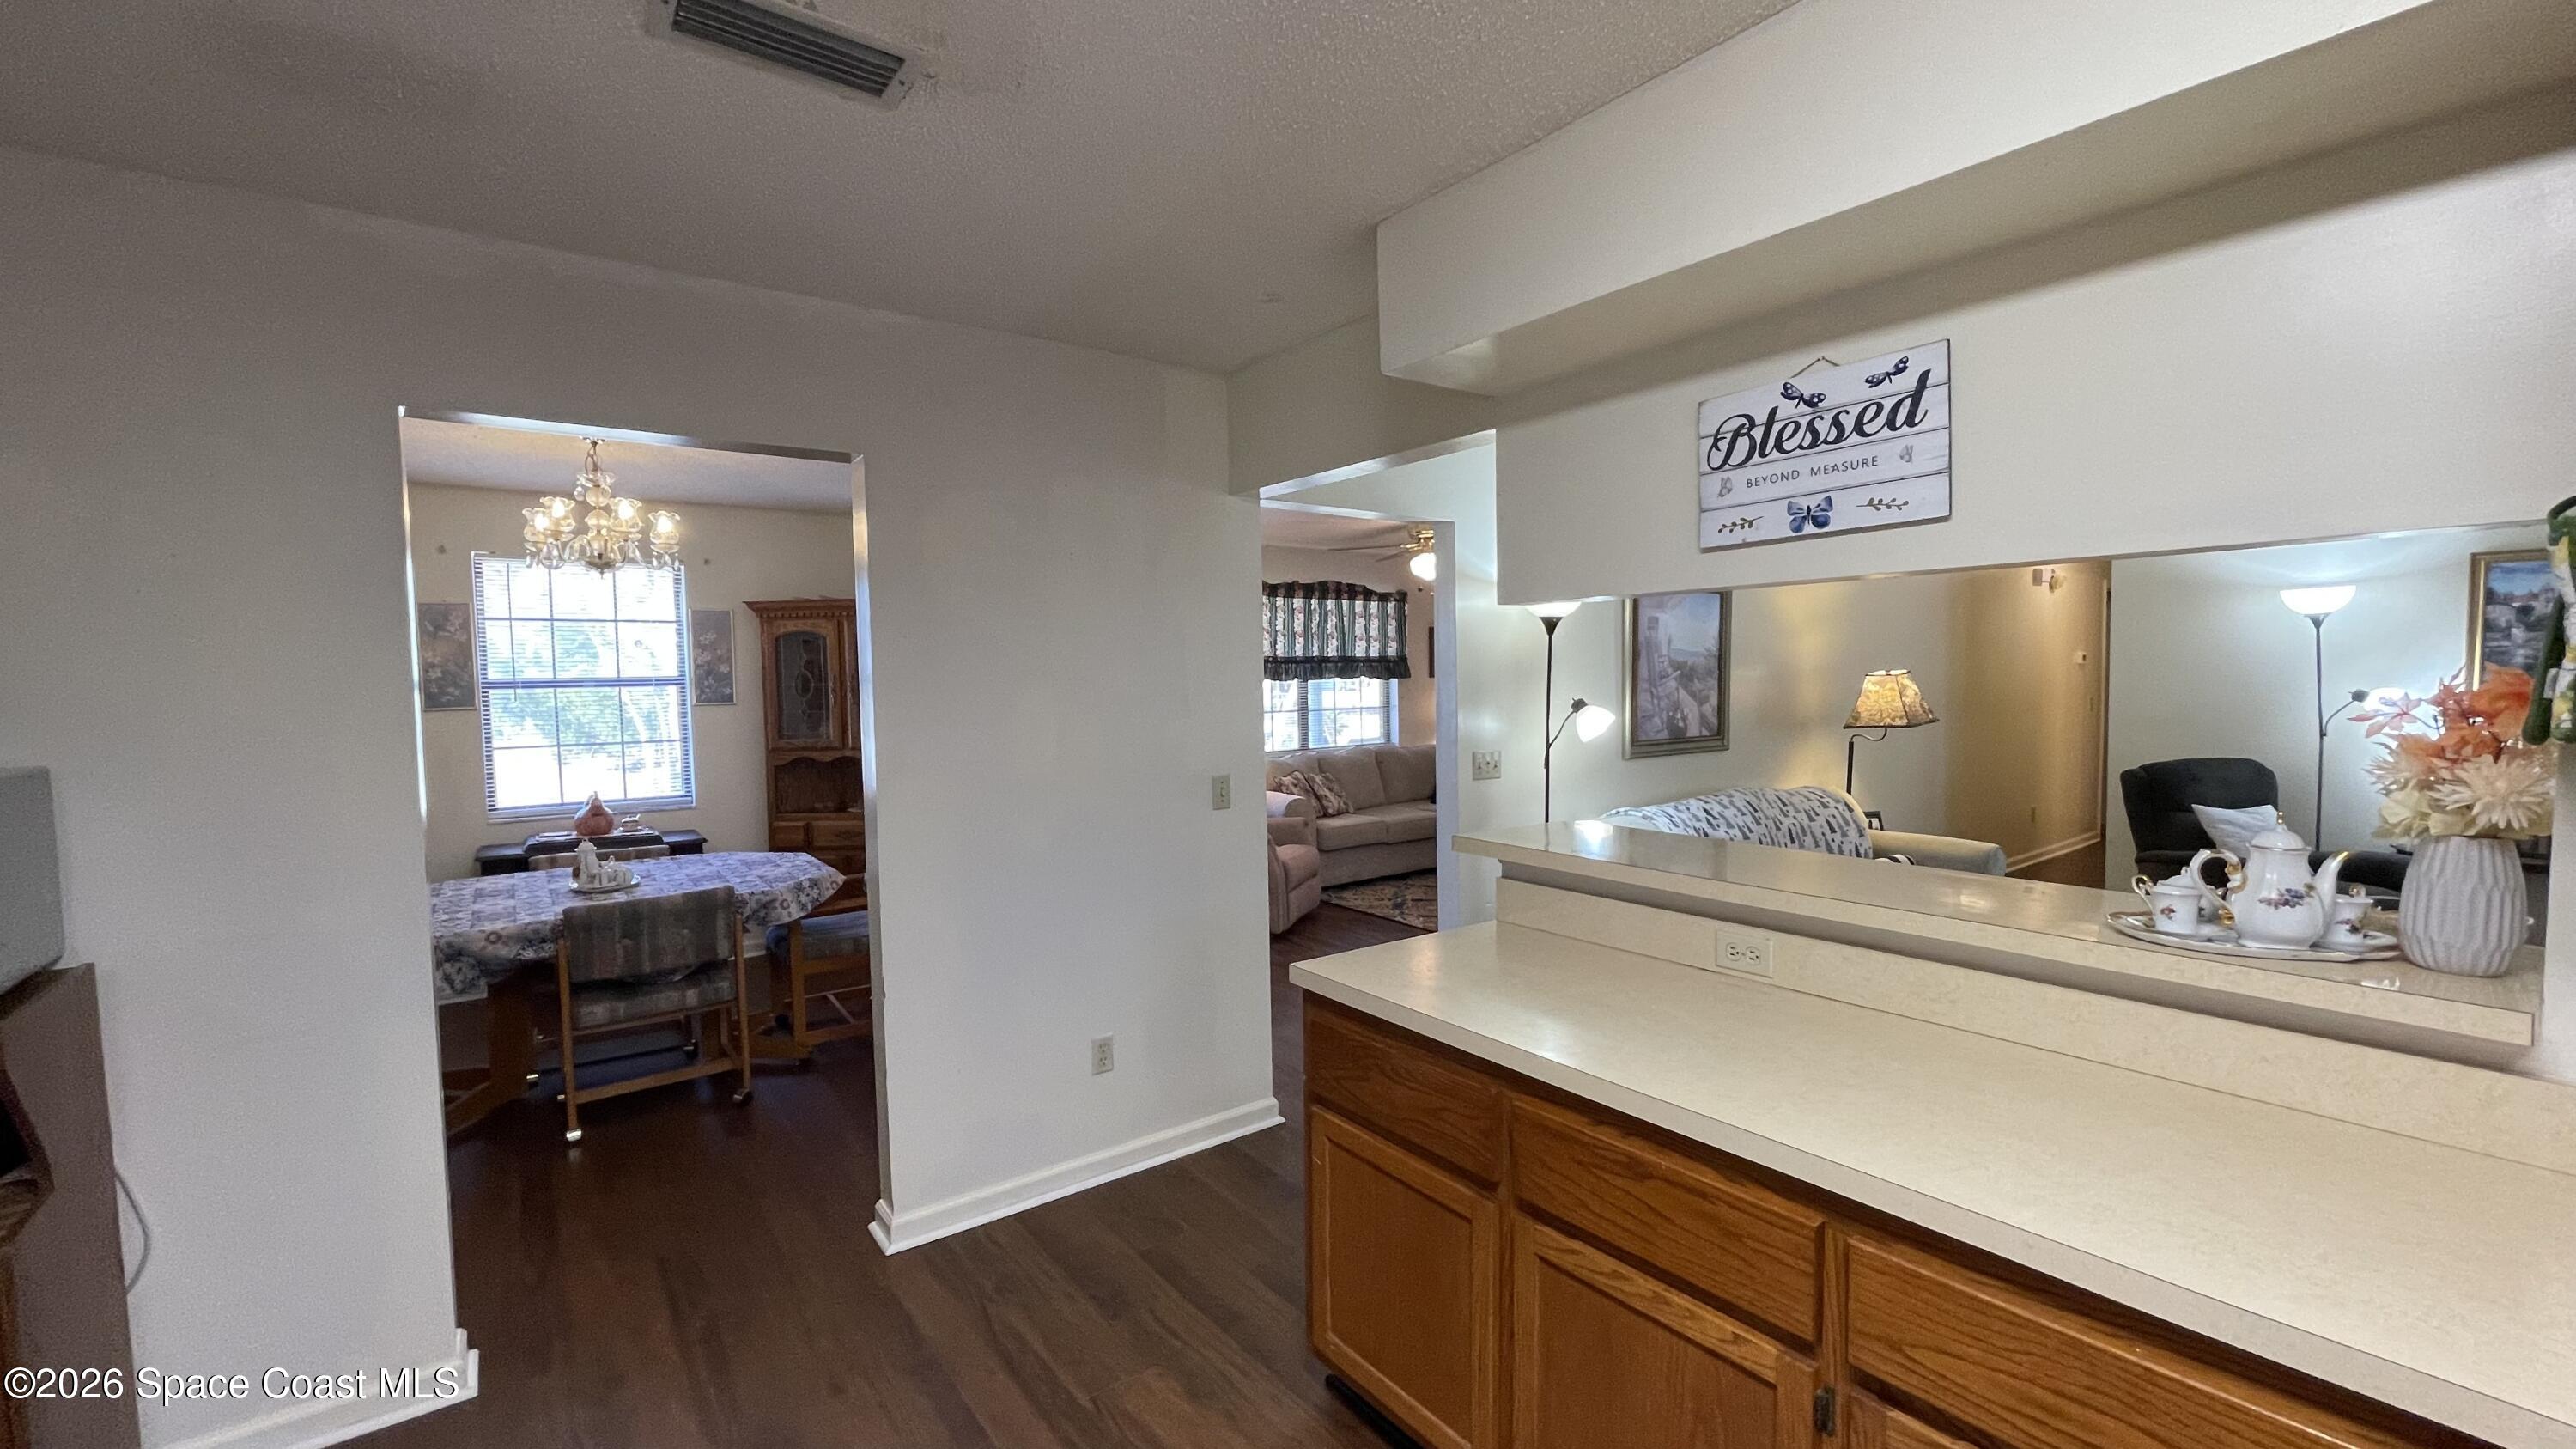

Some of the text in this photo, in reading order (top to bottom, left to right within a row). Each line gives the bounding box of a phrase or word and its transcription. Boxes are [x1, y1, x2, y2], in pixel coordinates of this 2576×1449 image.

[1707, 368, 1931, 471] Blessed
[1746, 456, 1879, 488] BEYOND MEASURE
